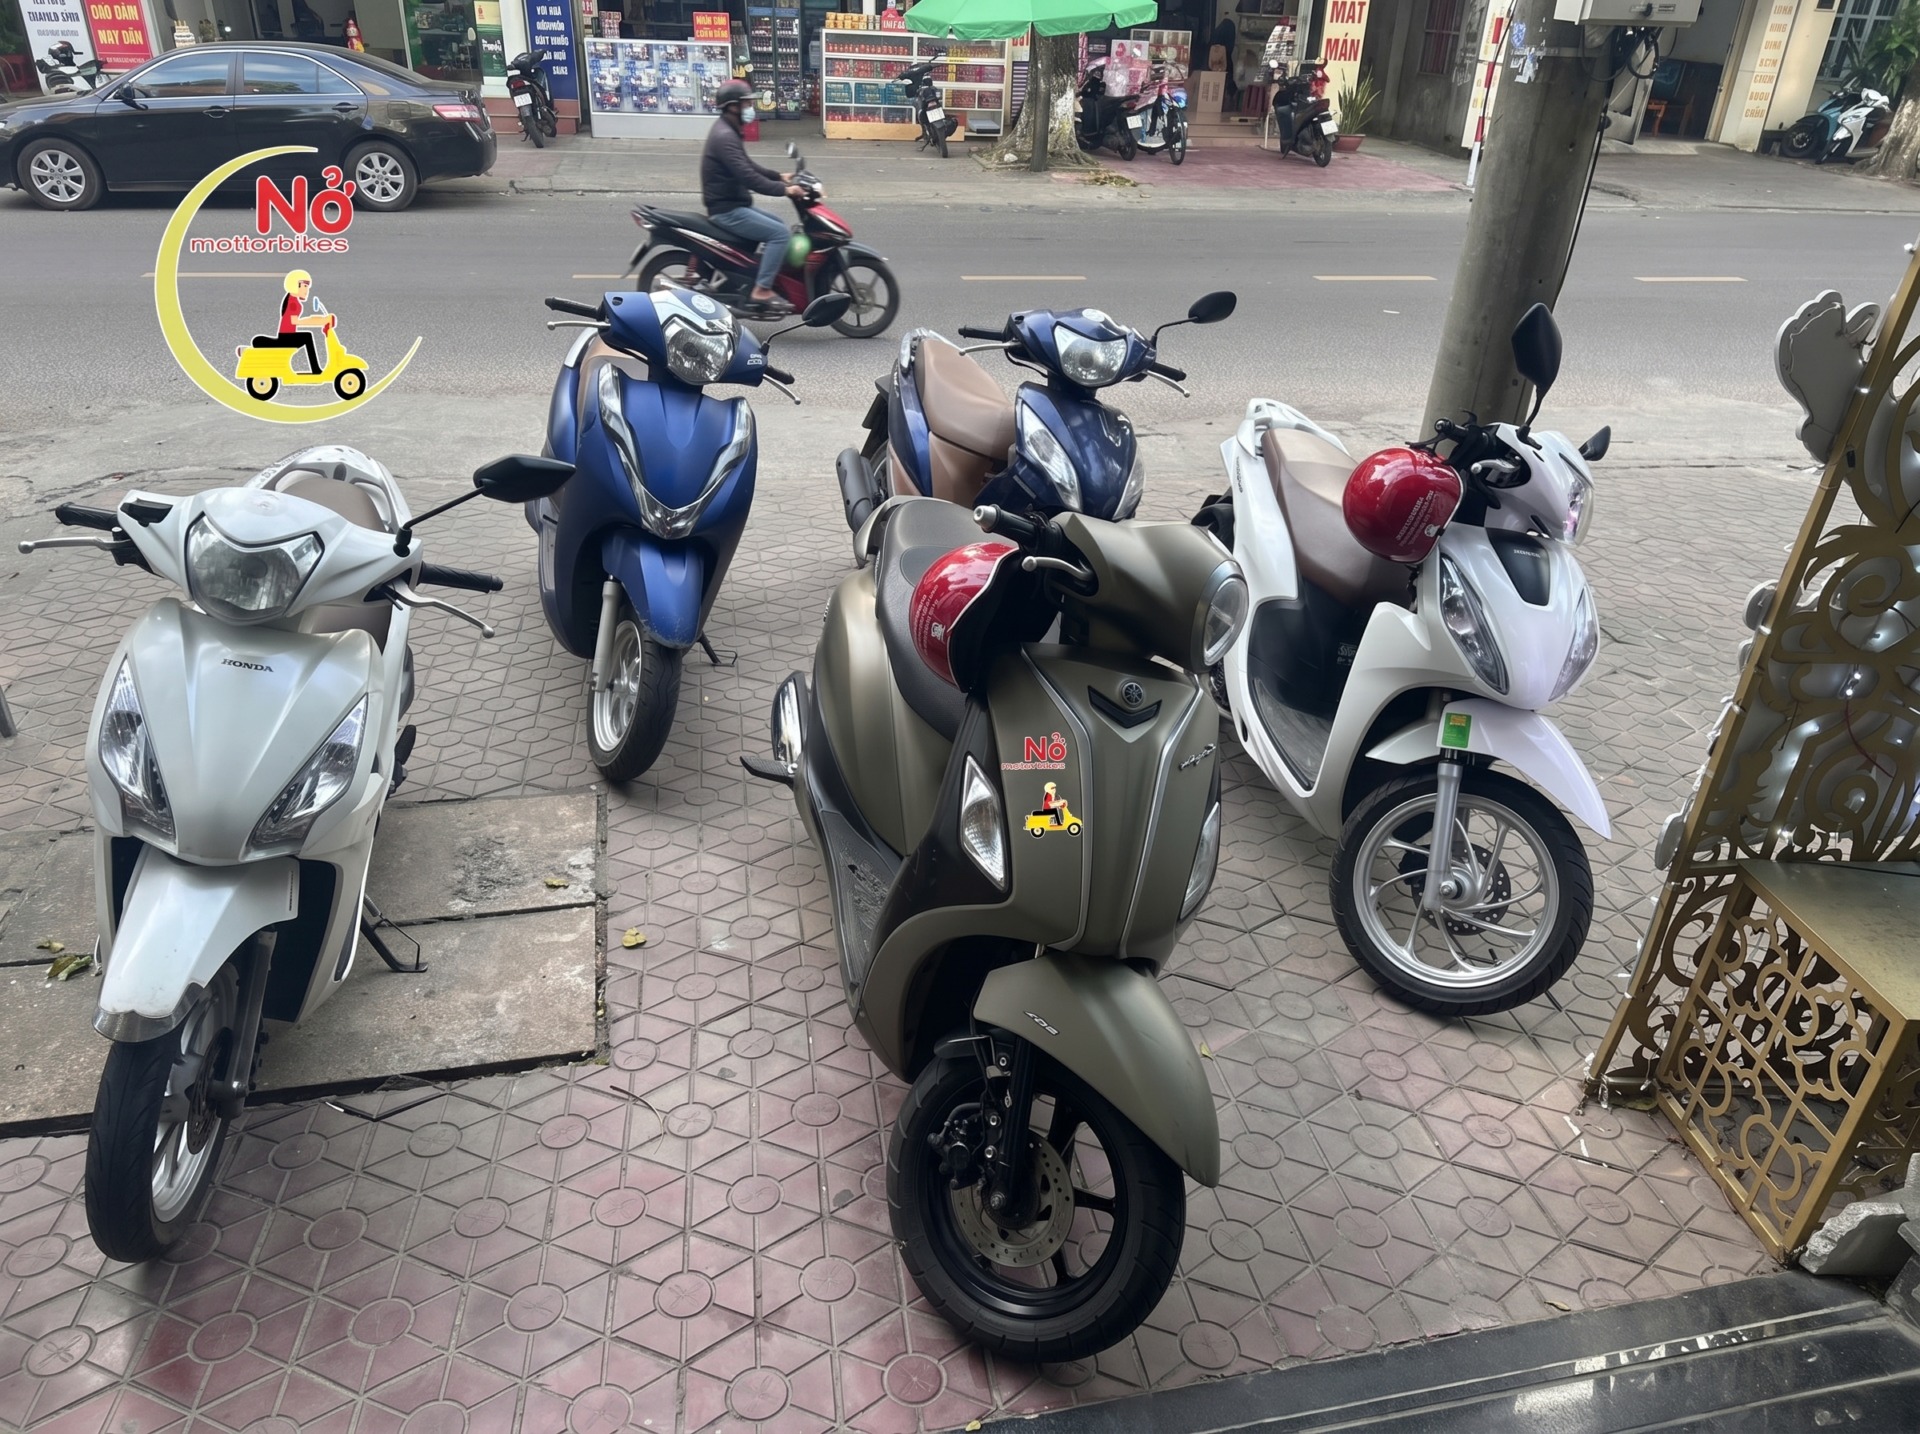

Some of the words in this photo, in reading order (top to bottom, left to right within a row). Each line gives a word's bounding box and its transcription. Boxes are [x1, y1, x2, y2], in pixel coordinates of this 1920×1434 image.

[1330, 1, 1366, 24] MAT
[1324, 32, 1360, 61] MÁN
[221, 658, 274, 672] HONDA
